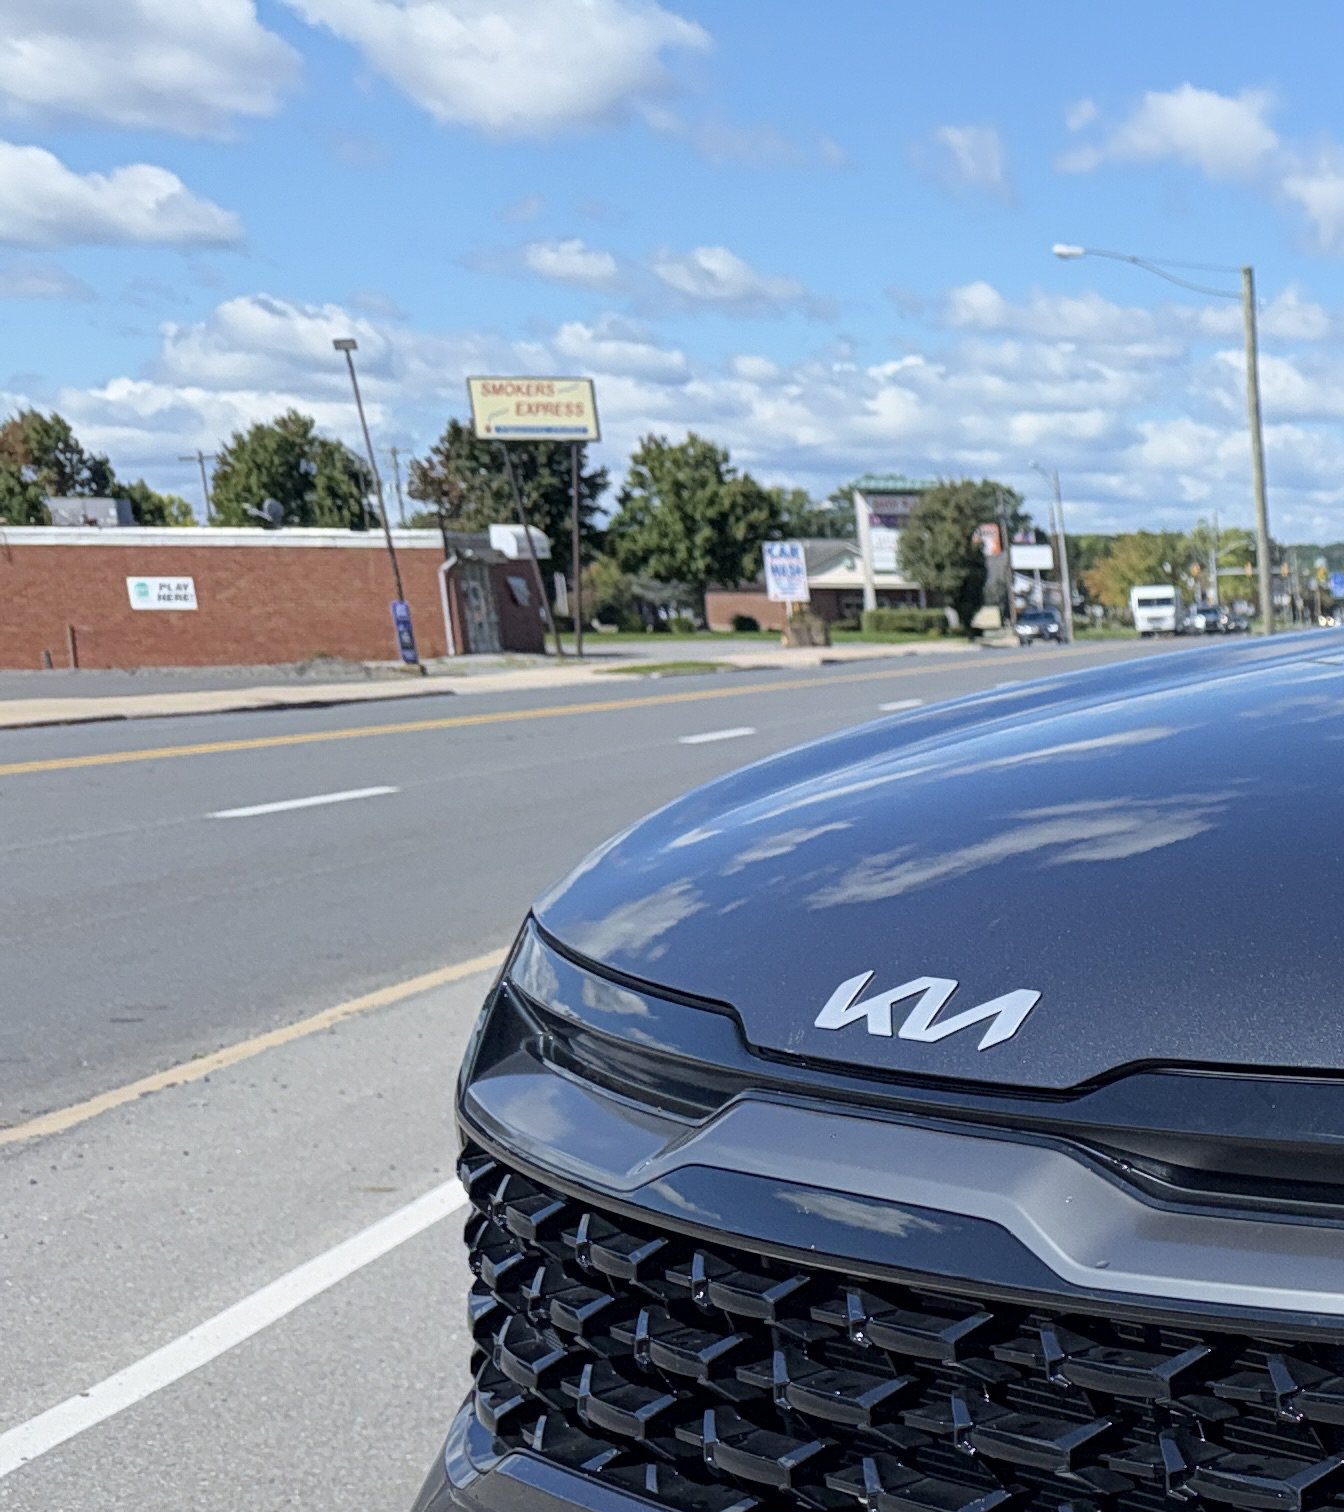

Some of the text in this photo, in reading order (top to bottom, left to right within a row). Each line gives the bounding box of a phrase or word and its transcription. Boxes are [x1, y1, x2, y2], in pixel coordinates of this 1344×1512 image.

[481, 381, 555, 396] SMOKERS
[515, 401, 584, 416] EXPRESS
[158, 583, 189, 592] PLAY
[814, 969, 1042, 1052] KIA
